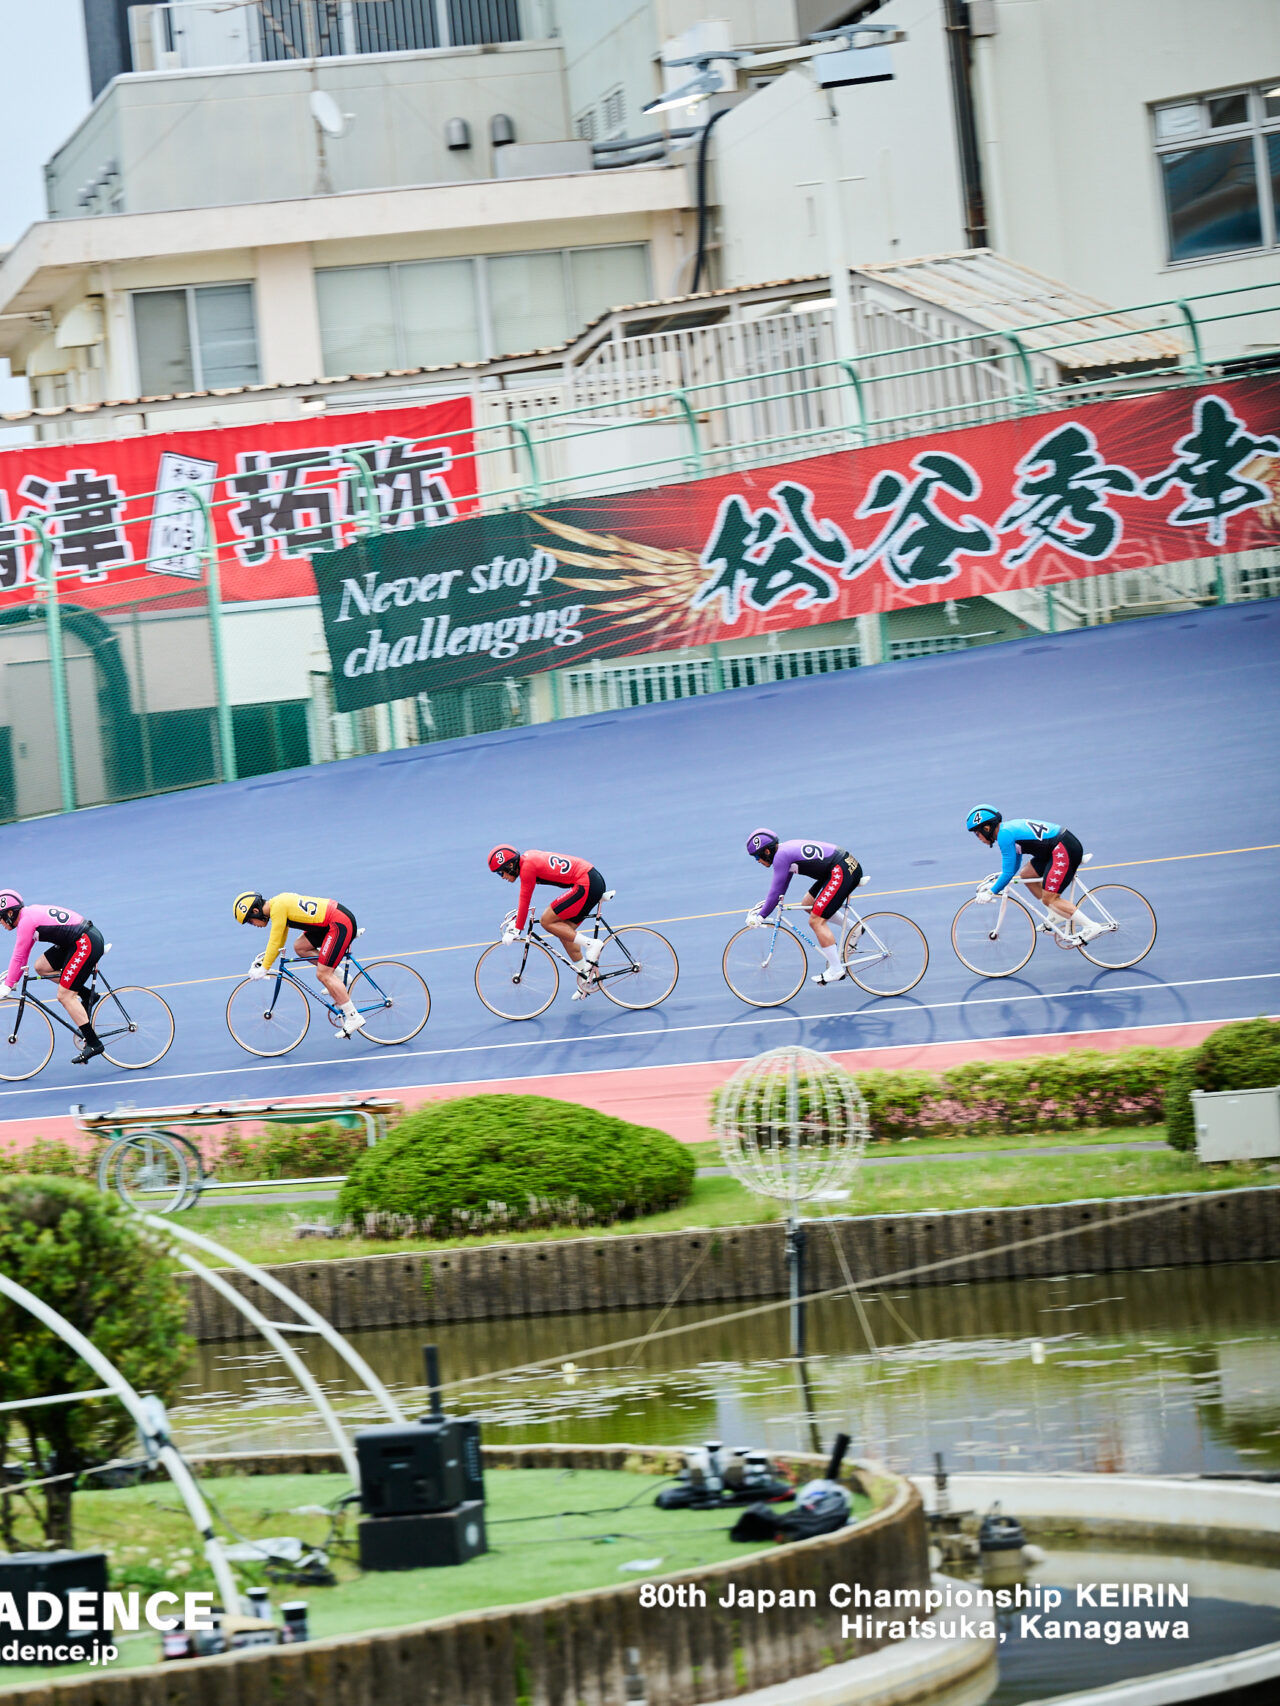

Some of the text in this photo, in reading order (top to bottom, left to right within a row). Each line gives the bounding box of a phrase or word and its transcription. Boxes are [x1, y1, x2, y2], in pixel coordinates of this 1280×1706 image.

[333, 548, 558, 623] Never stop
[343, 600, 586, 678] challenging
[973, 812, 982, 824] 4
[1026, 820, 1050, 841] 4
[495, 851, 505, 864] 3
[801, 843, 825, 861] 9
[548, 854, 573, 874] 3
[47, 905, 71, 926] 8
[298, 898, 318, 916] 5
